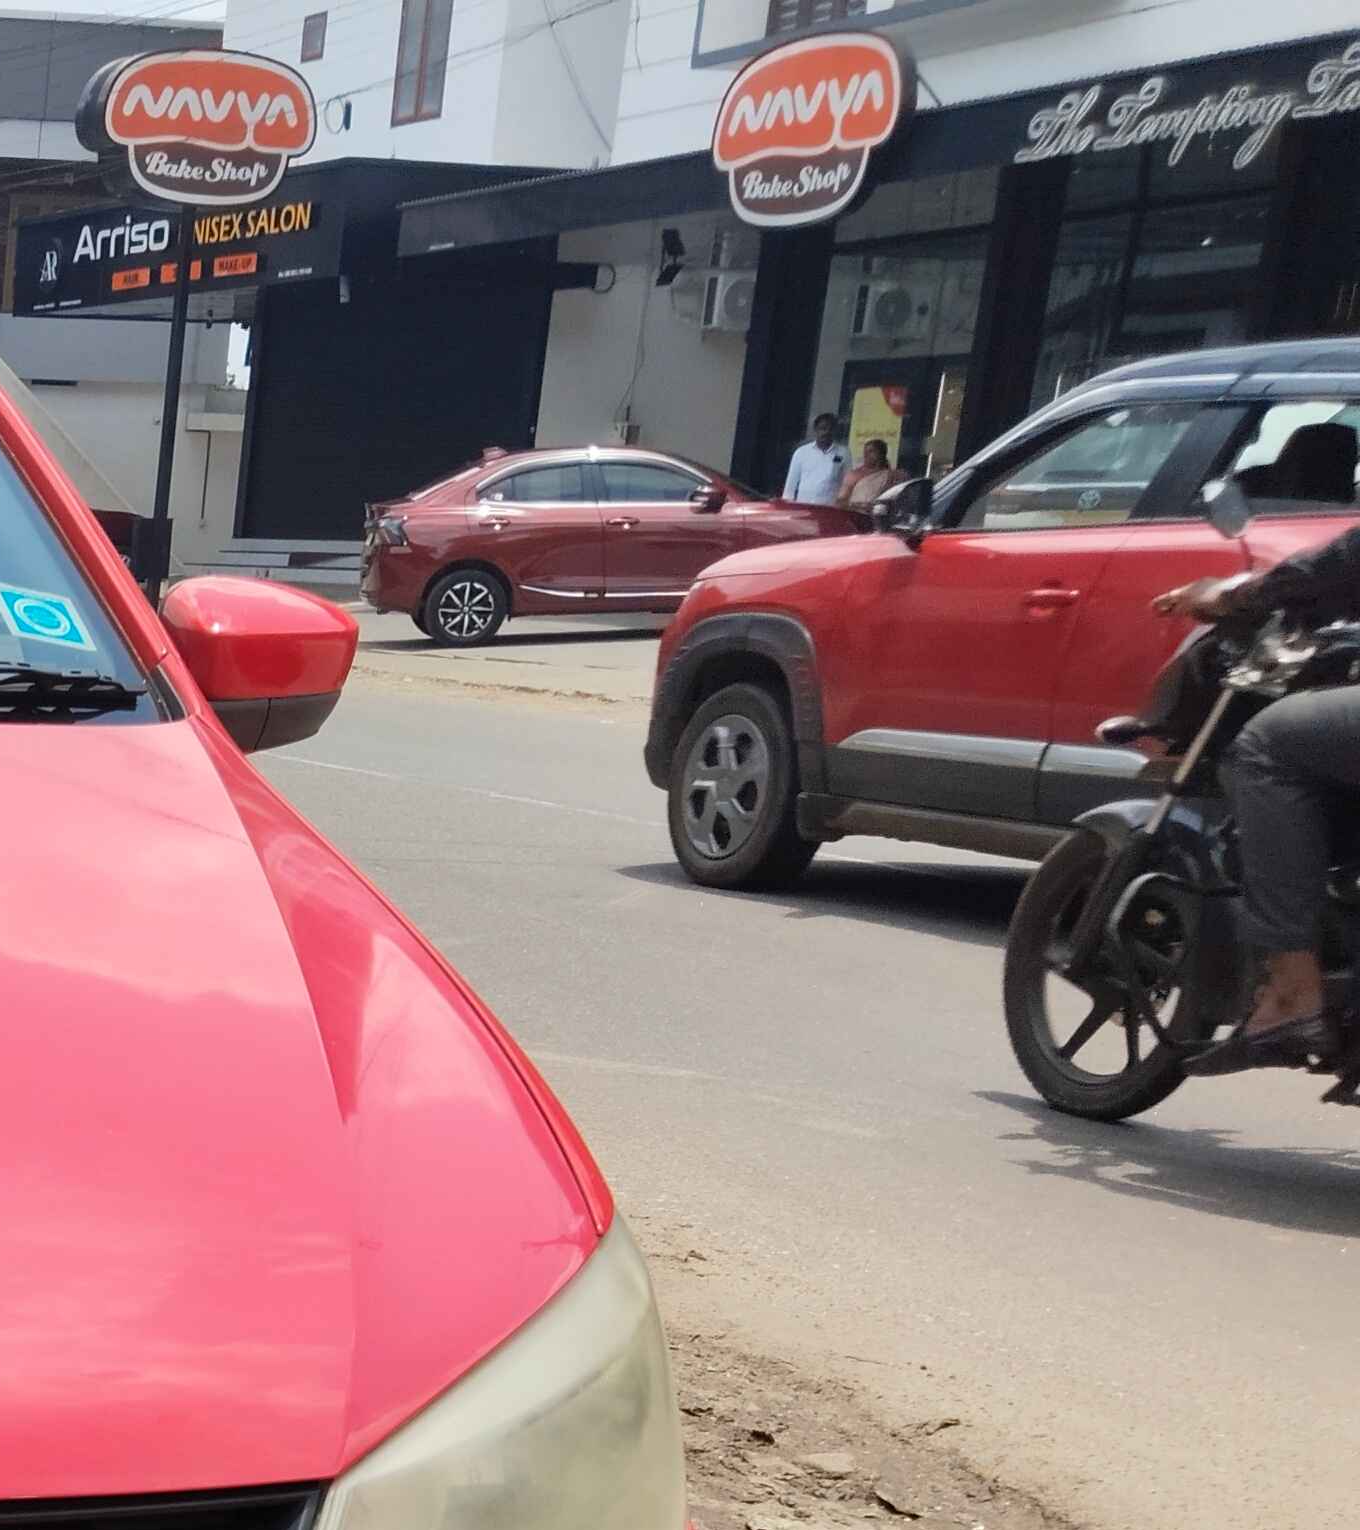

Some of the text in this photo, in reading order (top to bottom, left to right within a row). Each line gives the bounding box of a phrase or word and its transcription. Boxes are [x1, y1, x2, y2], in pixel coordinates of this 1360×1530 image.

[1014, 85, 1101, 163] The
[1093, 76, 1292, 169] Tempting
[145, 152, 268, 187] Bake Shop
[742, 162, 851, 199] Bake Shop
[73, 202, 312, 263] Arriso NISEX SALON
